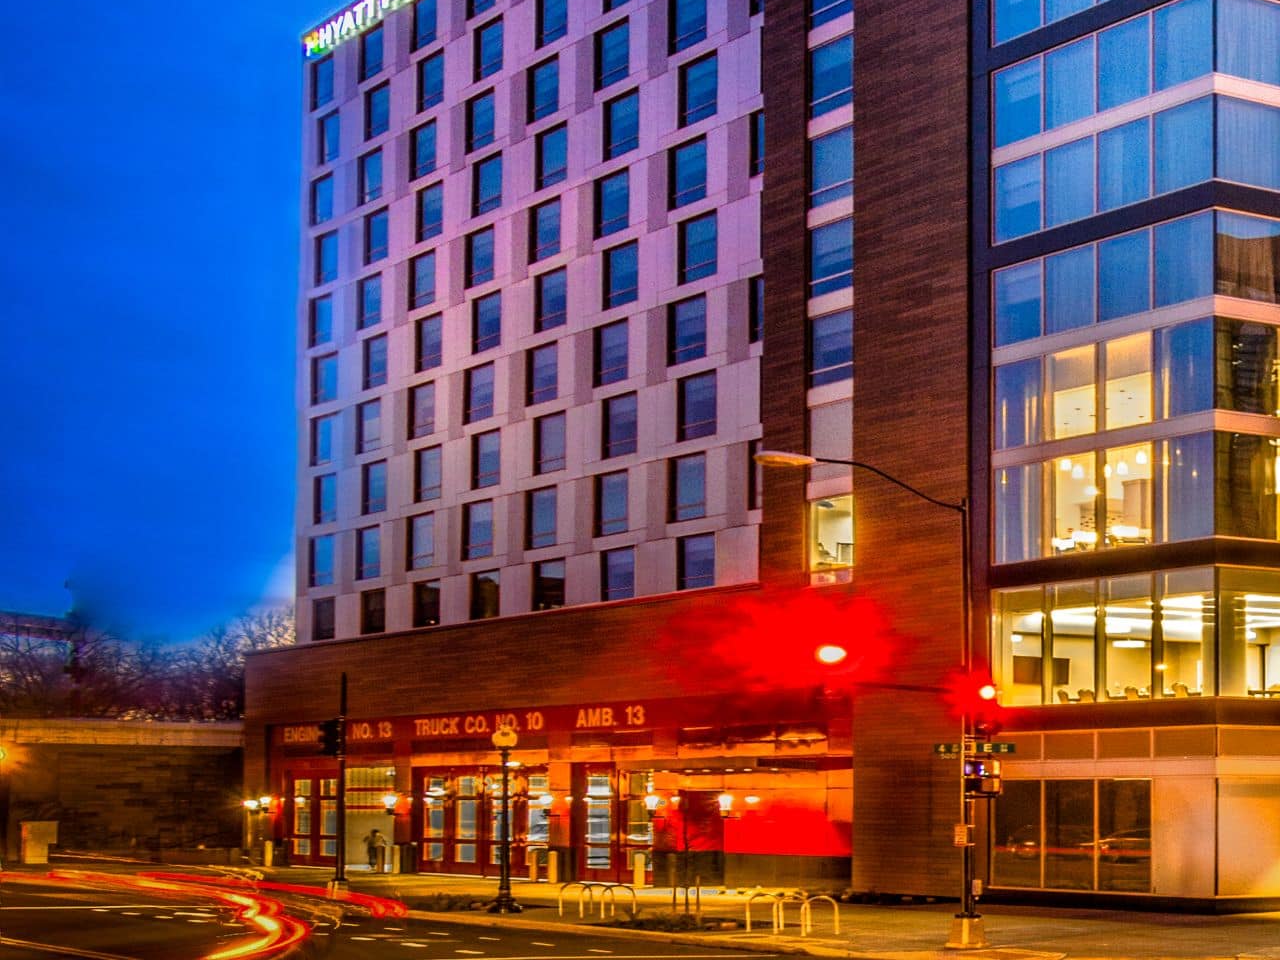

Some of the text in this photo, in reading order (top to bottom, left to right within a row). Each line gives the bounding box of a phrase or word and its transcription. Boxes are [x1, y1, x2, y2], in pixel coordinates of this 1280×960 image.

[414, 717, 460, 736] TRUCK
[464, 716, 490, 733] CO.
[525, 711, 544, 730] 10
[575, 705, 645, 728] AMB. 13
[284, 721, 392, 743] ENGIN NO. 13
